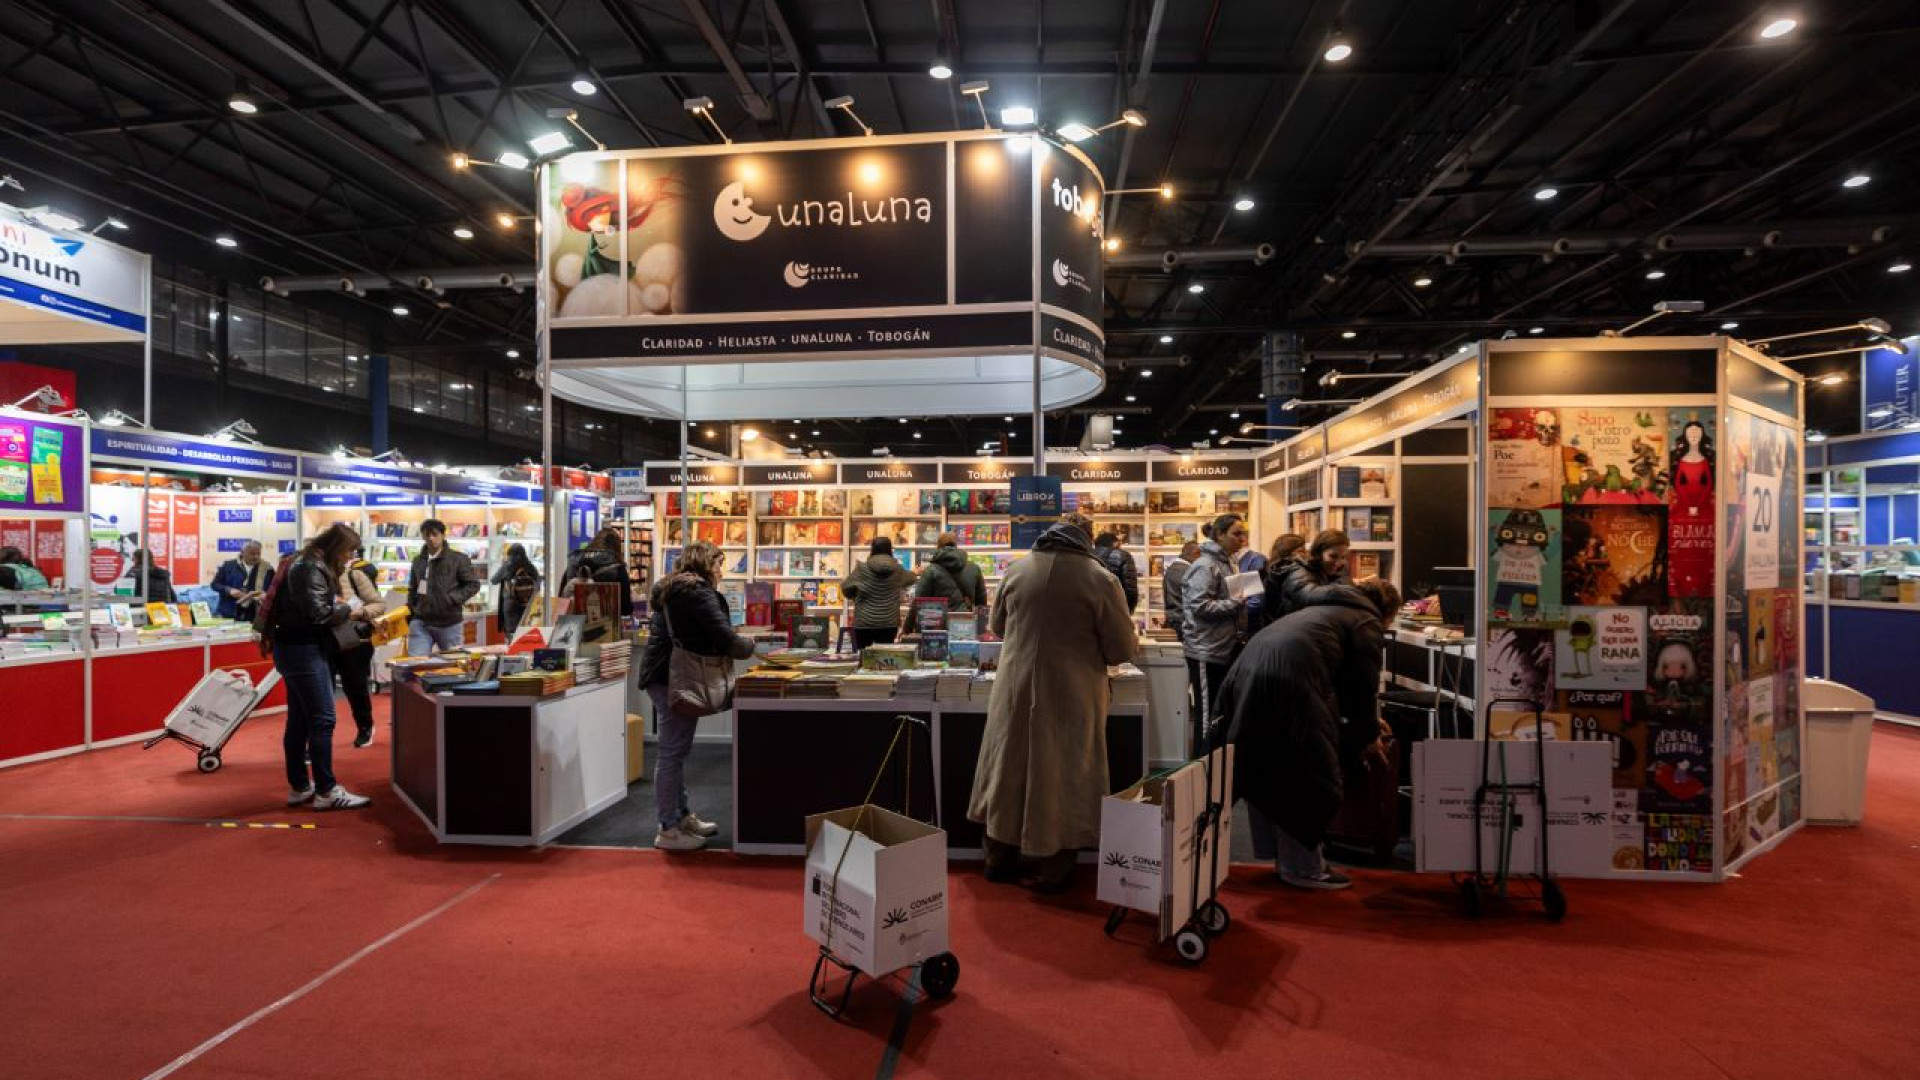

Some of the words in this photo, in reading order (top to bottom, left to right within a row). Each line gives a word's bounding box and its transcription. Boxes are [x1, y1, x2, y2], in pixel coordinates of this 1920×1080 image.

[811, 272, 859, 280] CLARIDAD
[642, 336, 703, 349] CLARIDAD
[717, 335, 776, 348] HELIASTA
[867, 327, 931, 342] TOBOGÁN
[1577, 410, 1615, 431] Sapo
[1605, 426, 1631, 436] otro
[1593, 436, 1620, 450] pozo
[107, 438, 178, 457] ESPIRITUALIDAD
[182, 448, 232, 464] DESARROLLO
[1494, 450, 1515, 460] Poe
[1071, 468, 1121, 480] CLARIDAD
[1178, 465, 1229, 476] CLARIDAD
[1752, 486, 1772, 534] 20
[1612, 613, 1630, 624] No
[1654, 616, 1699, 627] ALICIA
[1601, 647, 1640, 660] RANA
